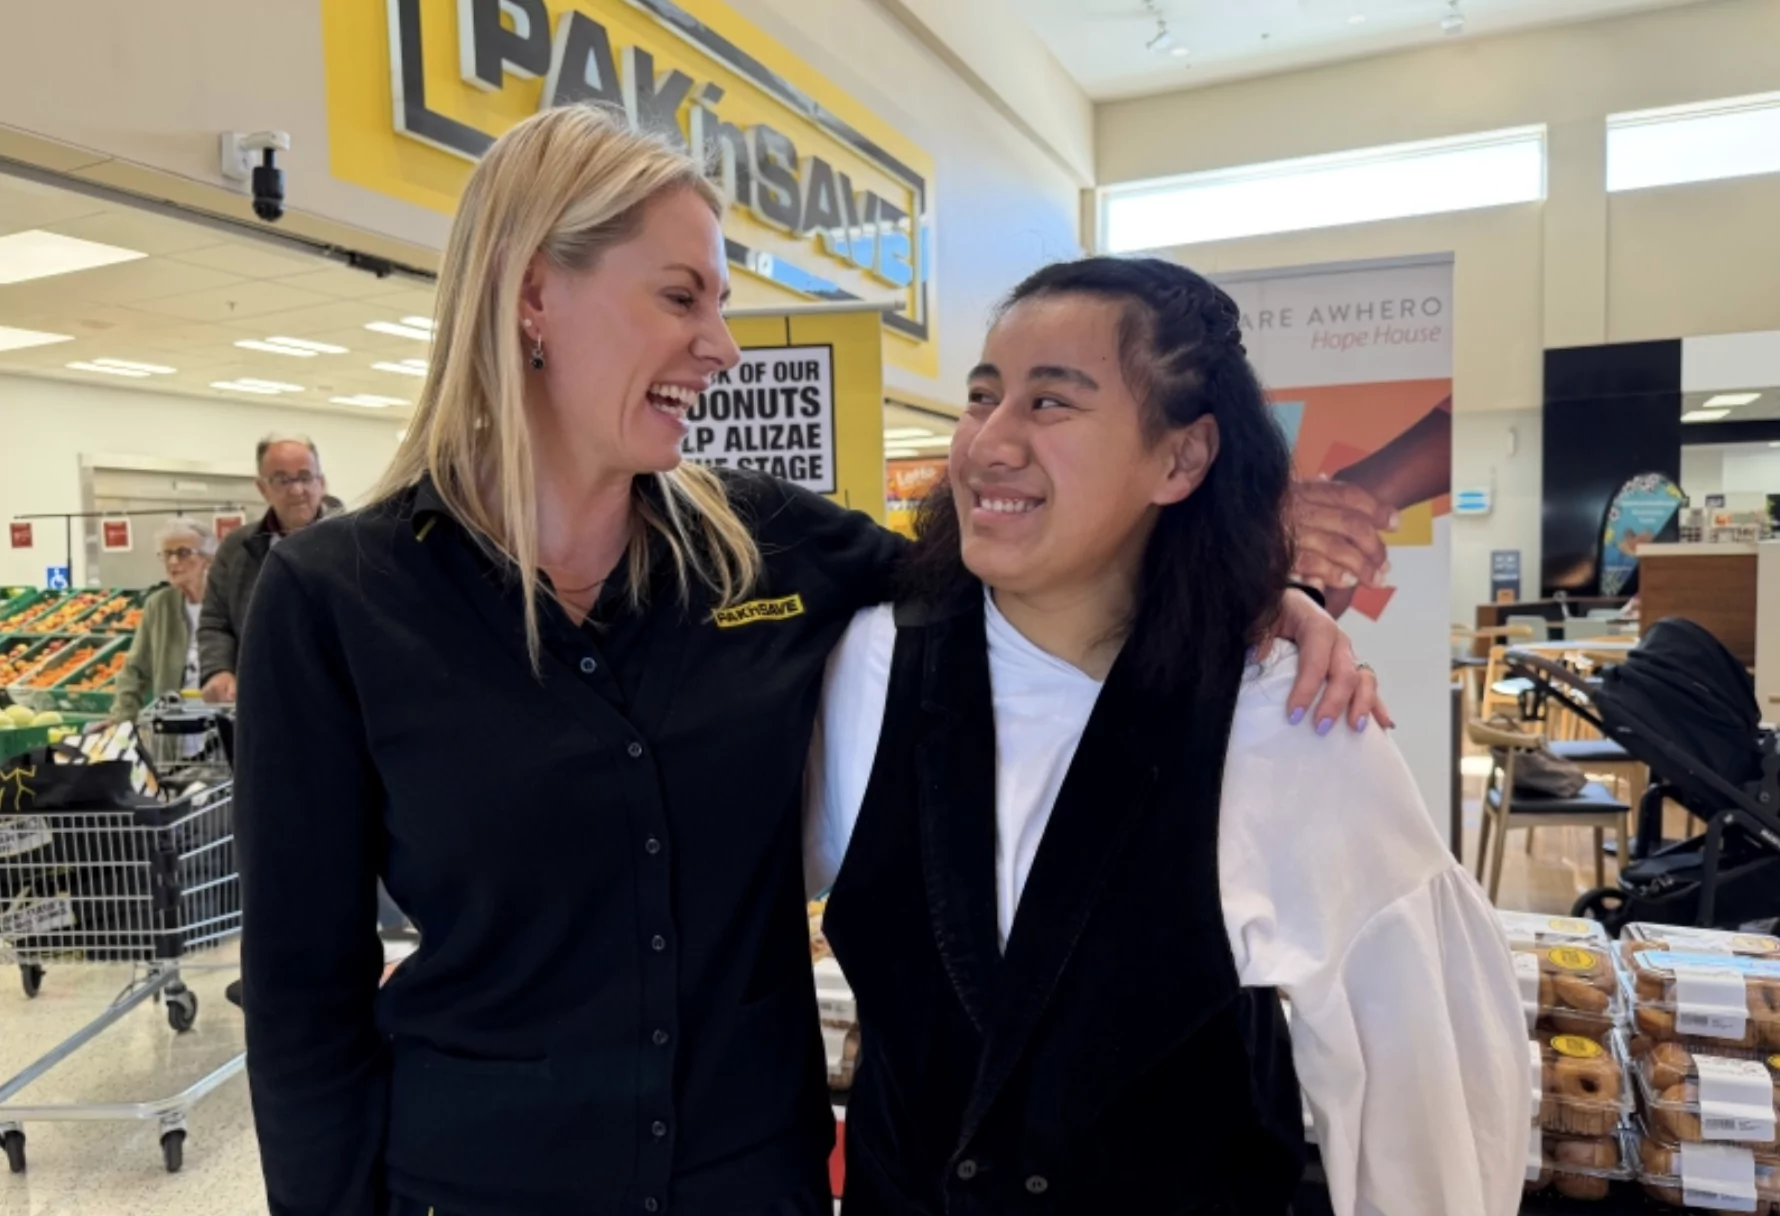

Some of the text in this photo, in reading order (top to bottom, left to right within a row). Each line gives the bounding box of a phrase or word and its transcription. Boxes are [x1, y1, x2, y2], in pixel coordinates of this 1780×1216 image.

[1306, 296, 1443, 326] AWHERO
[1311, 324, 1442, 351] Hope House
[739, 362, 766, 384] OF
[773, 360, 820, 383] OUR
[687, 386, 821, 422] DONUTS
[724, 423, 821, 452] ALIZAE
[737, 455, 823, 481] STAGE
